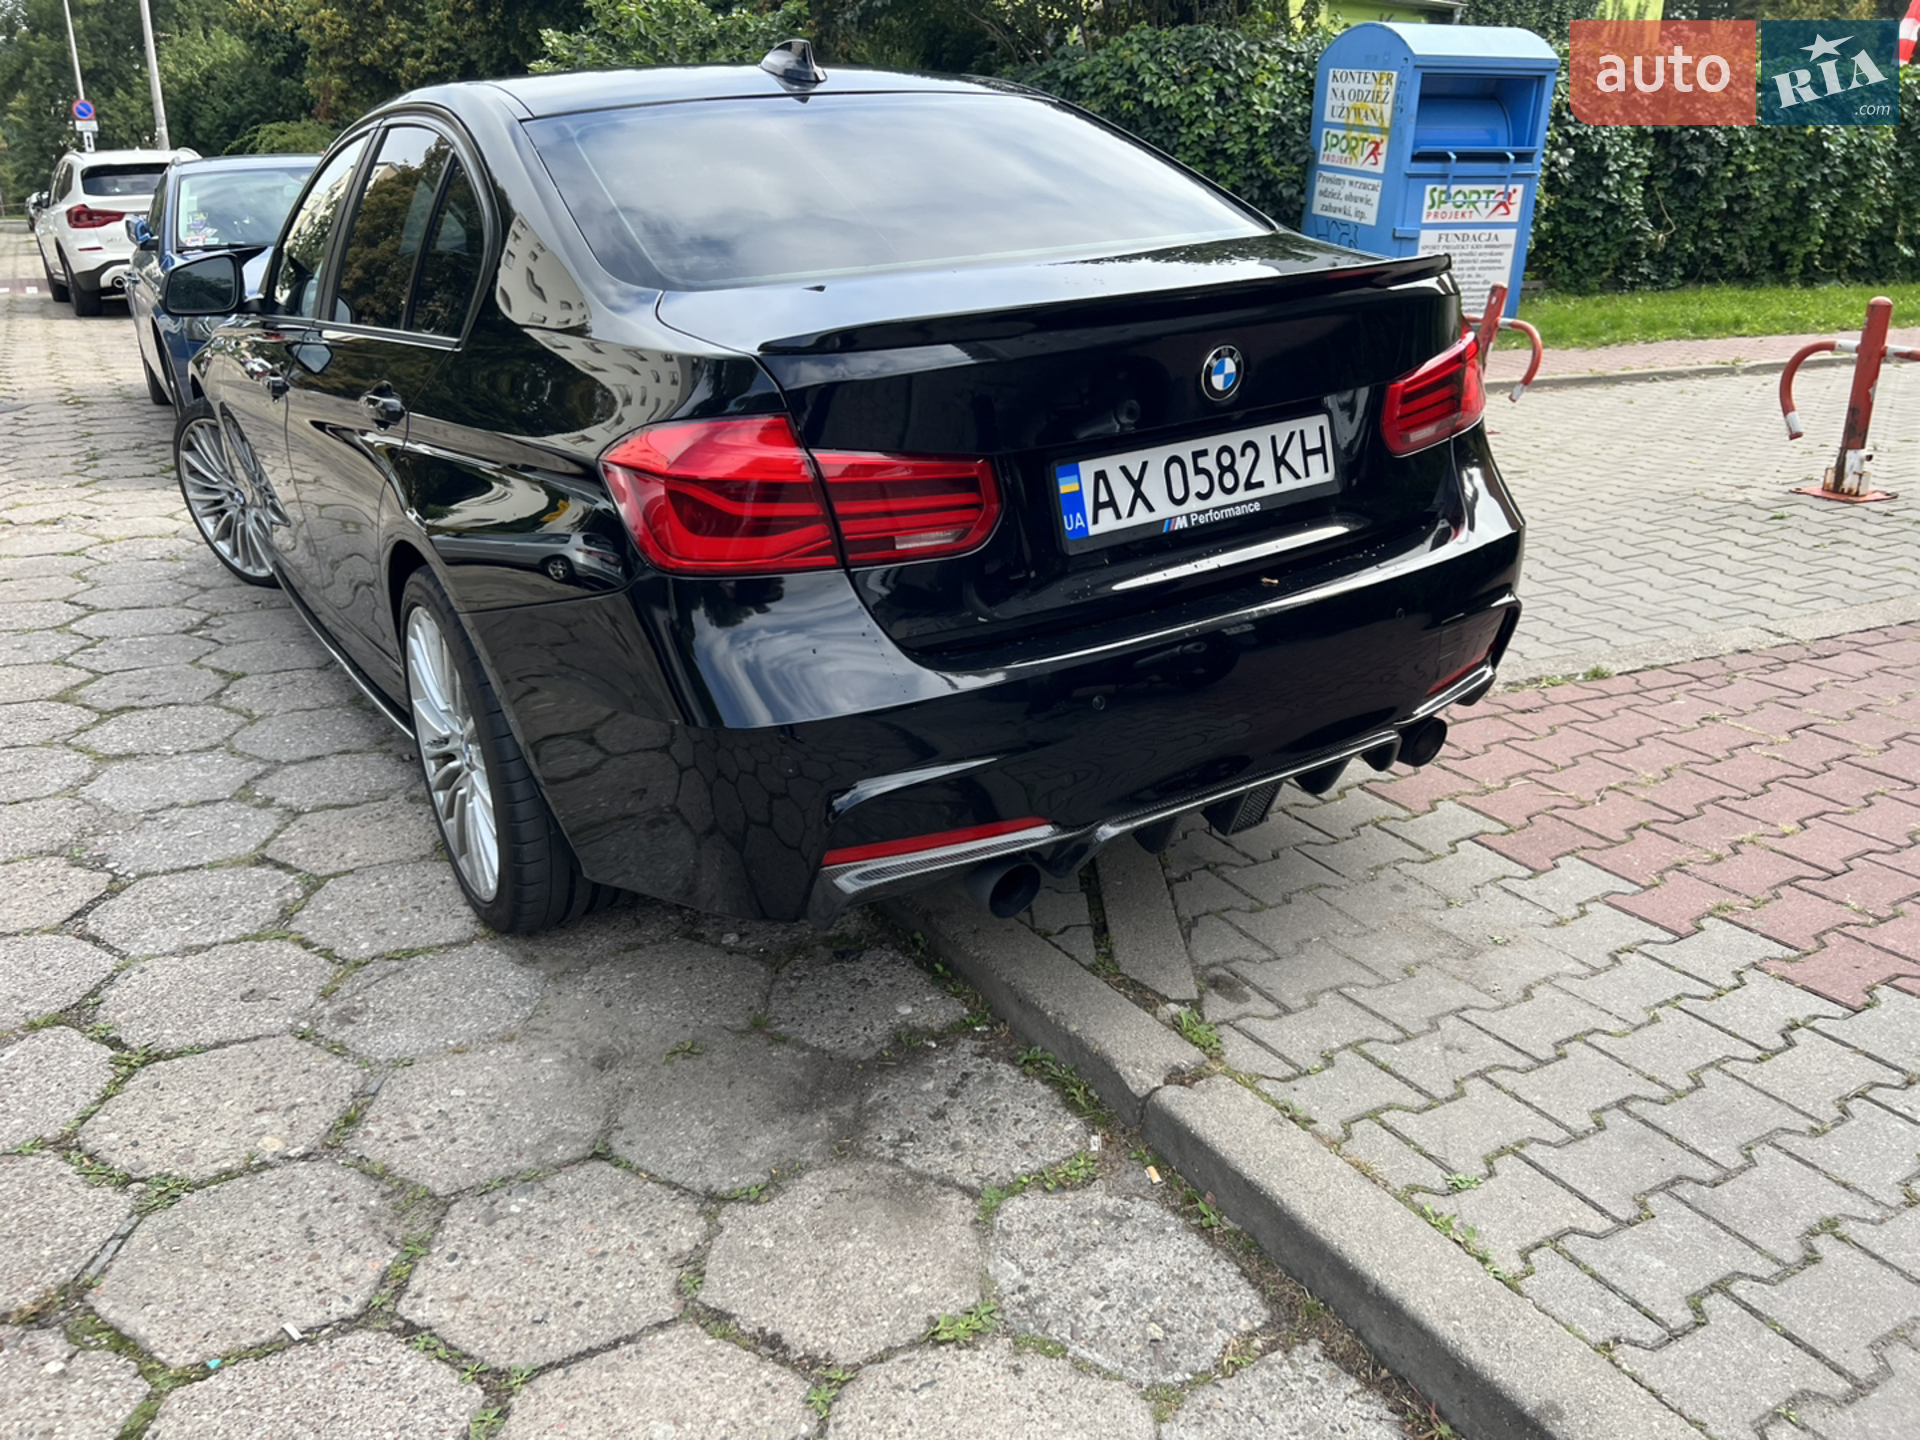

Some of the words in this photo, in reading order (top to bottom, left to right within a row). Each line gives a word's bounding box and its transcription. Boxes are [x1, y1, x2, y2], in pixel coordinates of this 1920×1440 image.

[1331, 70, 1394, 87] KONTENER
[1330, 87, 1345, 102] NA
[1348, 87, 1390, 104] ODZIEŻ
[1323, 130, 1369, 164] SPORT
[1322, 153, 1353, 165] PROJEKT
[1317, 172, 1346, 189] Prosimy
[1344, 191, 1374, 207] obuwie,
[1427, 187, 1496, 217] SPORT
[1426, 210, 1474, 219] PROJEKT
[1437, 232, 1499, 243] FUNDACJA
[1091, 460, 1156, 526] AX
[1164, 440, 1265, 507] 0582
[1270, 425, 1329, 484] KH
[1063, 511, 1086, 532] UA
[1190, 501, 1261, 527] Performance
